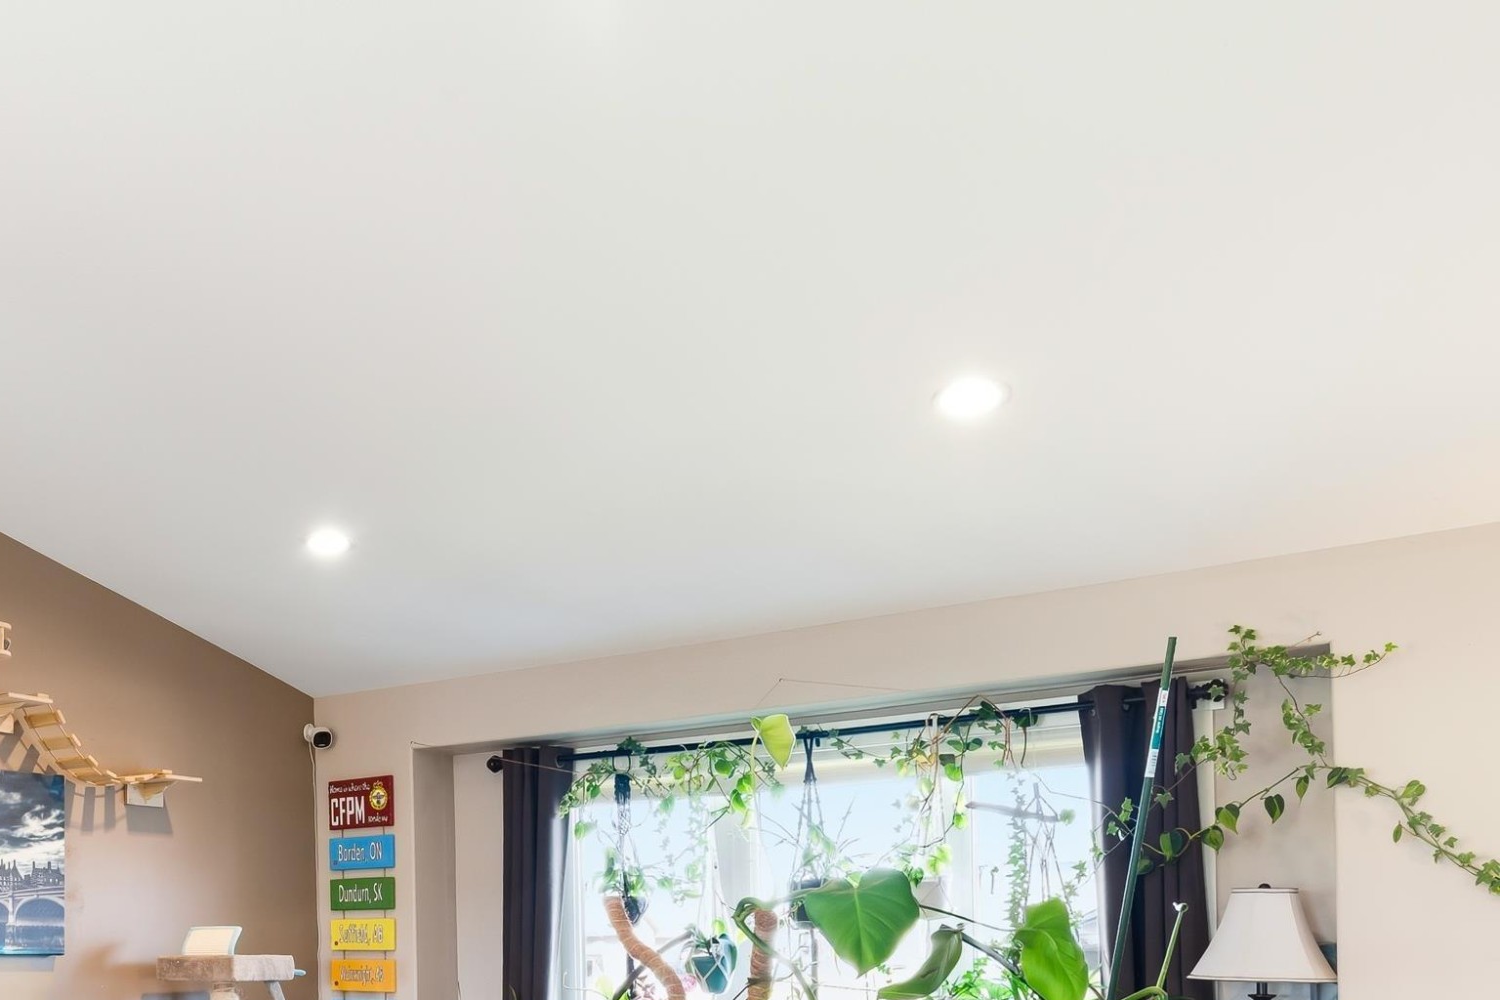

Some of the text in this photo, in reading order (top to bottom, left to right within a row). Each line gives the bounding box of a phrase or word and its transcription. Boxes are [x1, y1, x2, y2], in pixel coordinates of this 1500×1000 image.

[331, 796, 365, 826] CFPM
[370, 842, 382, 860] ON
[338, 882, 382, 904] Dundurn, SK
